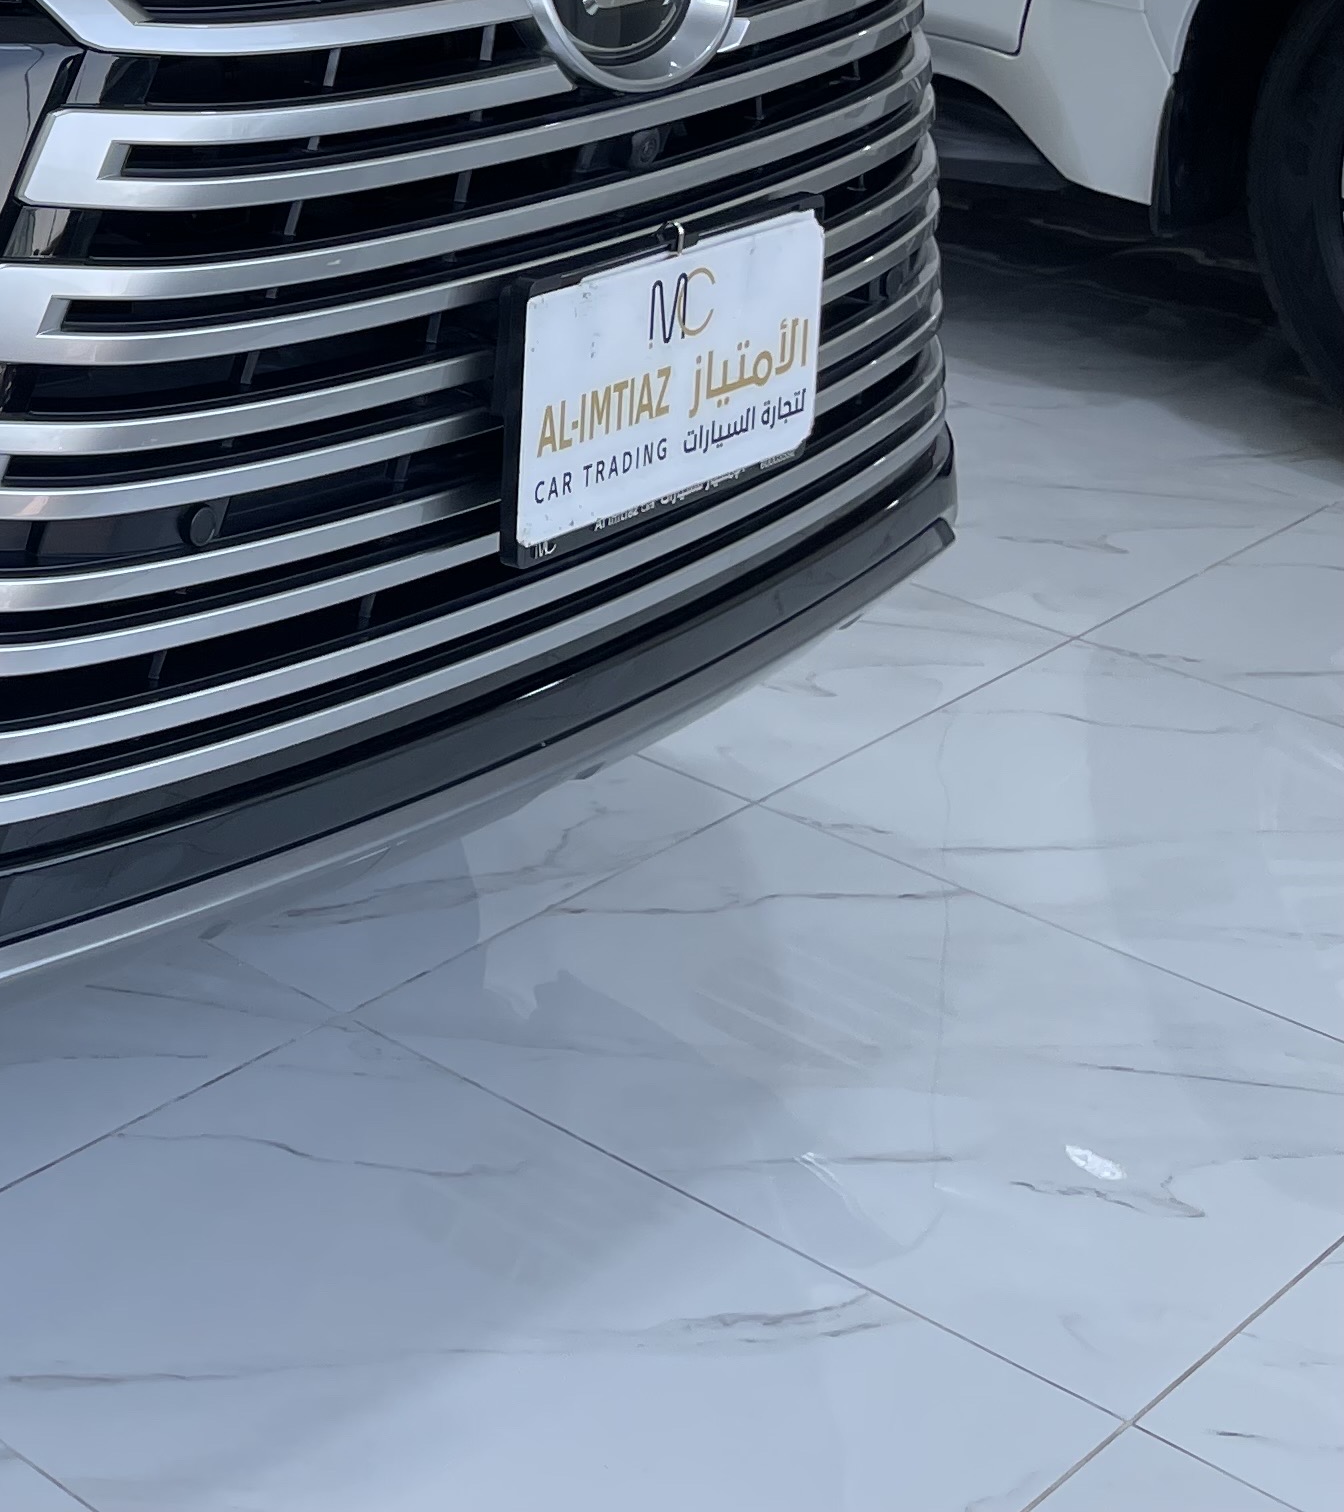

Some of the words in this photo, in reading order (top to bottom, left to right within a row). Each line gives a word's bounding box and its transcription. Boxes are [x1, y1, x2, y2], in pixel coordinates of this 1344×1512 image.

[536, 365, 672, 458] AL-IMTIAZ
[683, 405, 757, 454] السيارات
[760, 387, 807, 430] لتجارة
[534, 471, 572, 505] CAR
[583, 438, 668, 488] TRADING
